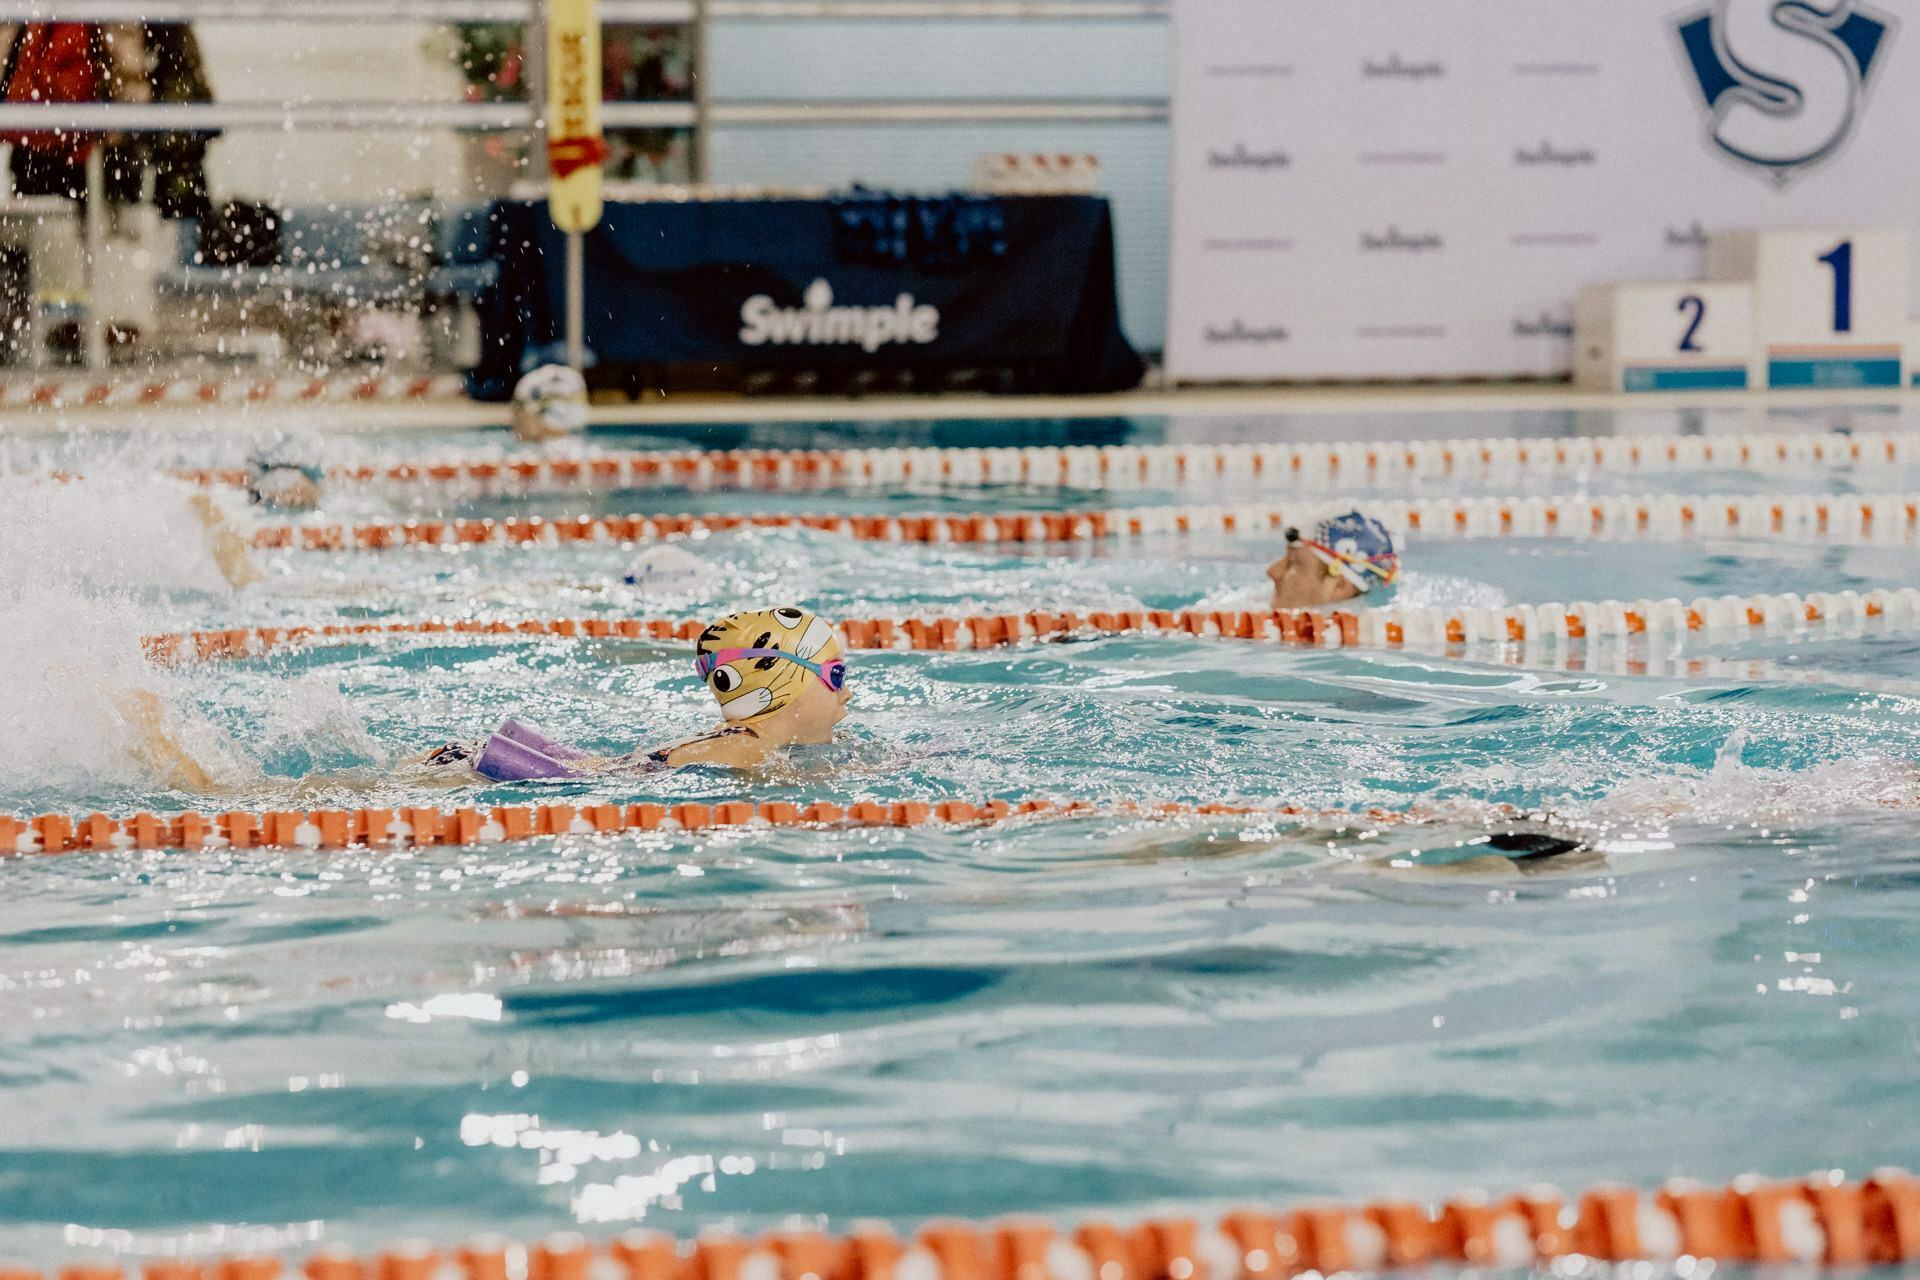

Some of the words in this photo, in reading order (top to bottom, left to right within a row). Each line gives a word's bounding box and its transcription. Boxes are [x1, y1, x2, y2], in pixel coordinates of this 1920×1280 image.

[739, 277, 939, 353] Swimple
[1678, 295, 1705, 351] 2
[1817, 239, 1851, 332] 1
